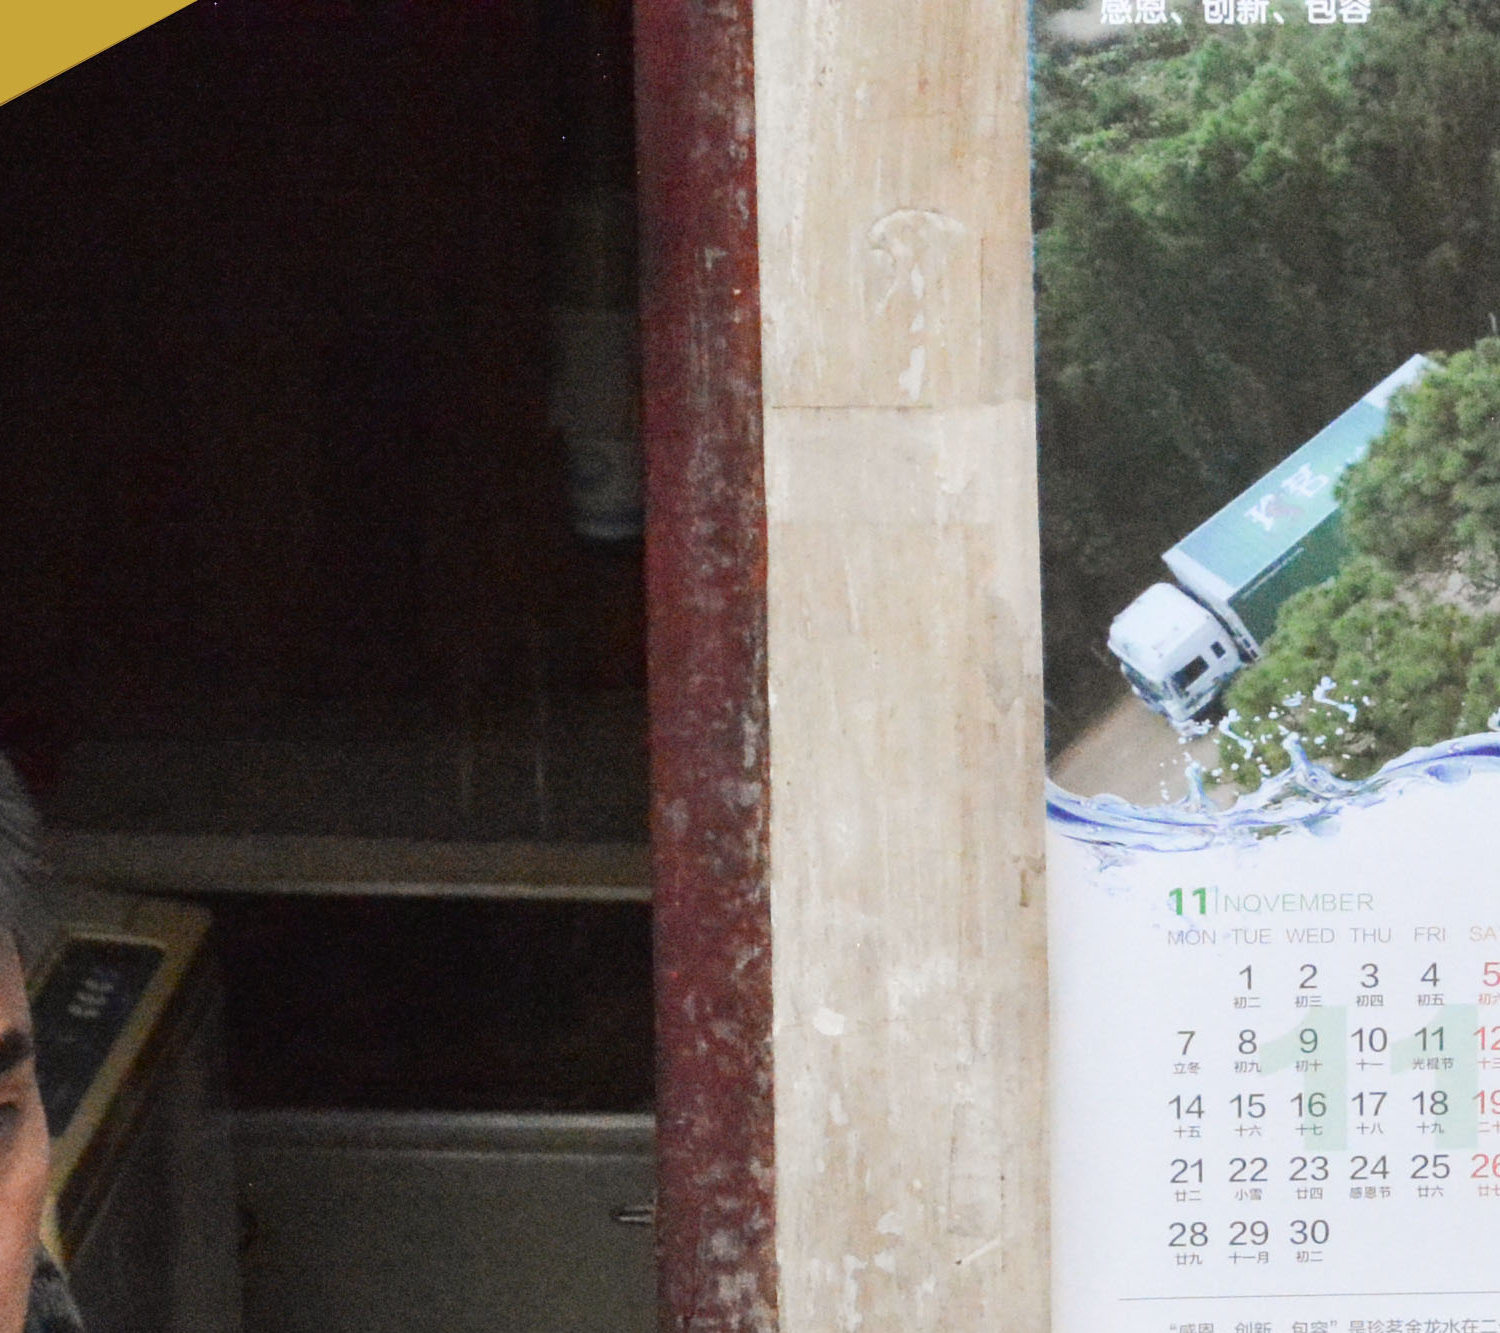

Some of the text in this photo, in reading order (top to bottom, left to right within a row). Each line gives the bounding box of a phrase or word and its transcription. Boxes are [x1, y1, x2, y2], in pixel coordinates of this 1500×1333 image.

[1100, 0, 1371, 25] 感恩、创新、包容
[1169, 888, 1206, 916] 11
[1224, 893, 1374, 914] NOVEMBER
[1168, 930, 1216, 944] MON
[1232, 929, 1272, 944] TUE
[1286, 928, 1335, 943] WED
[1350, 928, 1391, 943] THU
[1414, 927, 1445, 942] FRI
[1240, 965, 1251, 990] 1
[1300, 964, 1317, 989] 2
[1361, 963, 1379, 988] 3
[1421, 963, 1440, 987] 4
[1483, 962, 1500, 987] 5
[1234, 997, 1260, 1009] 初二
[1295, 996, 1322, 1008] 初三
[1356, 995, 1383, 1007] 初四
[1418, 993, 1444, 1006] 初五
[1178, 1031, 1195, 1055] 7
[1238, 1029, 1257, 1054] 8
[1300, 1028, 1318, 1053] 9
[1351, 1027, 1387, 1052] 10
[1415, 1027, 1443, 1051] 11
[1174, 1062, 1200, 1074] 立冬
[1234, 1061, 1261, 1073] 初九
[1295, 1059, 1322, 1072] 初十
[1356, 1059, 1383, 1071] 十一
[1413, 1056, 1454, 1070] 光棍节
[1169, 1095, 1204, 1119] 14
[1230, 1094, 1266, 1118] 15
[1291, 1092, 1326, 1117] 16
[1352, 1092, 1387, 1116] 17
[1412, 1091, 1448, 1115] 18
[1174, 1126, 1200, 1138] 十五
[1234, 1124, 1262, 1137] 十六
[1295, 1124, 1323, 1136] 十七
[1356, 1122, 1383, 1135] 十八
[1417, 1121, 1444, 1134] 十九
[1171, 1159, 1202, 1183] 21
[1229, 1157, 1268, 1182] 22
[1289, 1156, 1329, 1181] 23
[1350, 1156, 1389, 1180] 24
[1411, 1154, 1450, 1179] 25
[1174, 1190, 1200, 1202] 廿二
[1235, 1188, 1262, 1201] 小雪
[1296, 1187, 1323, 1199] 廿四
[1349, 1186, 1391, 1199] 感恩节
[1417, 1185, 1443, 1198] 廿六
[1169, 1220, 1329, 1247] 28 29 30
[1176, 1251, 1323, 1265] 廿九 十一月 初二
